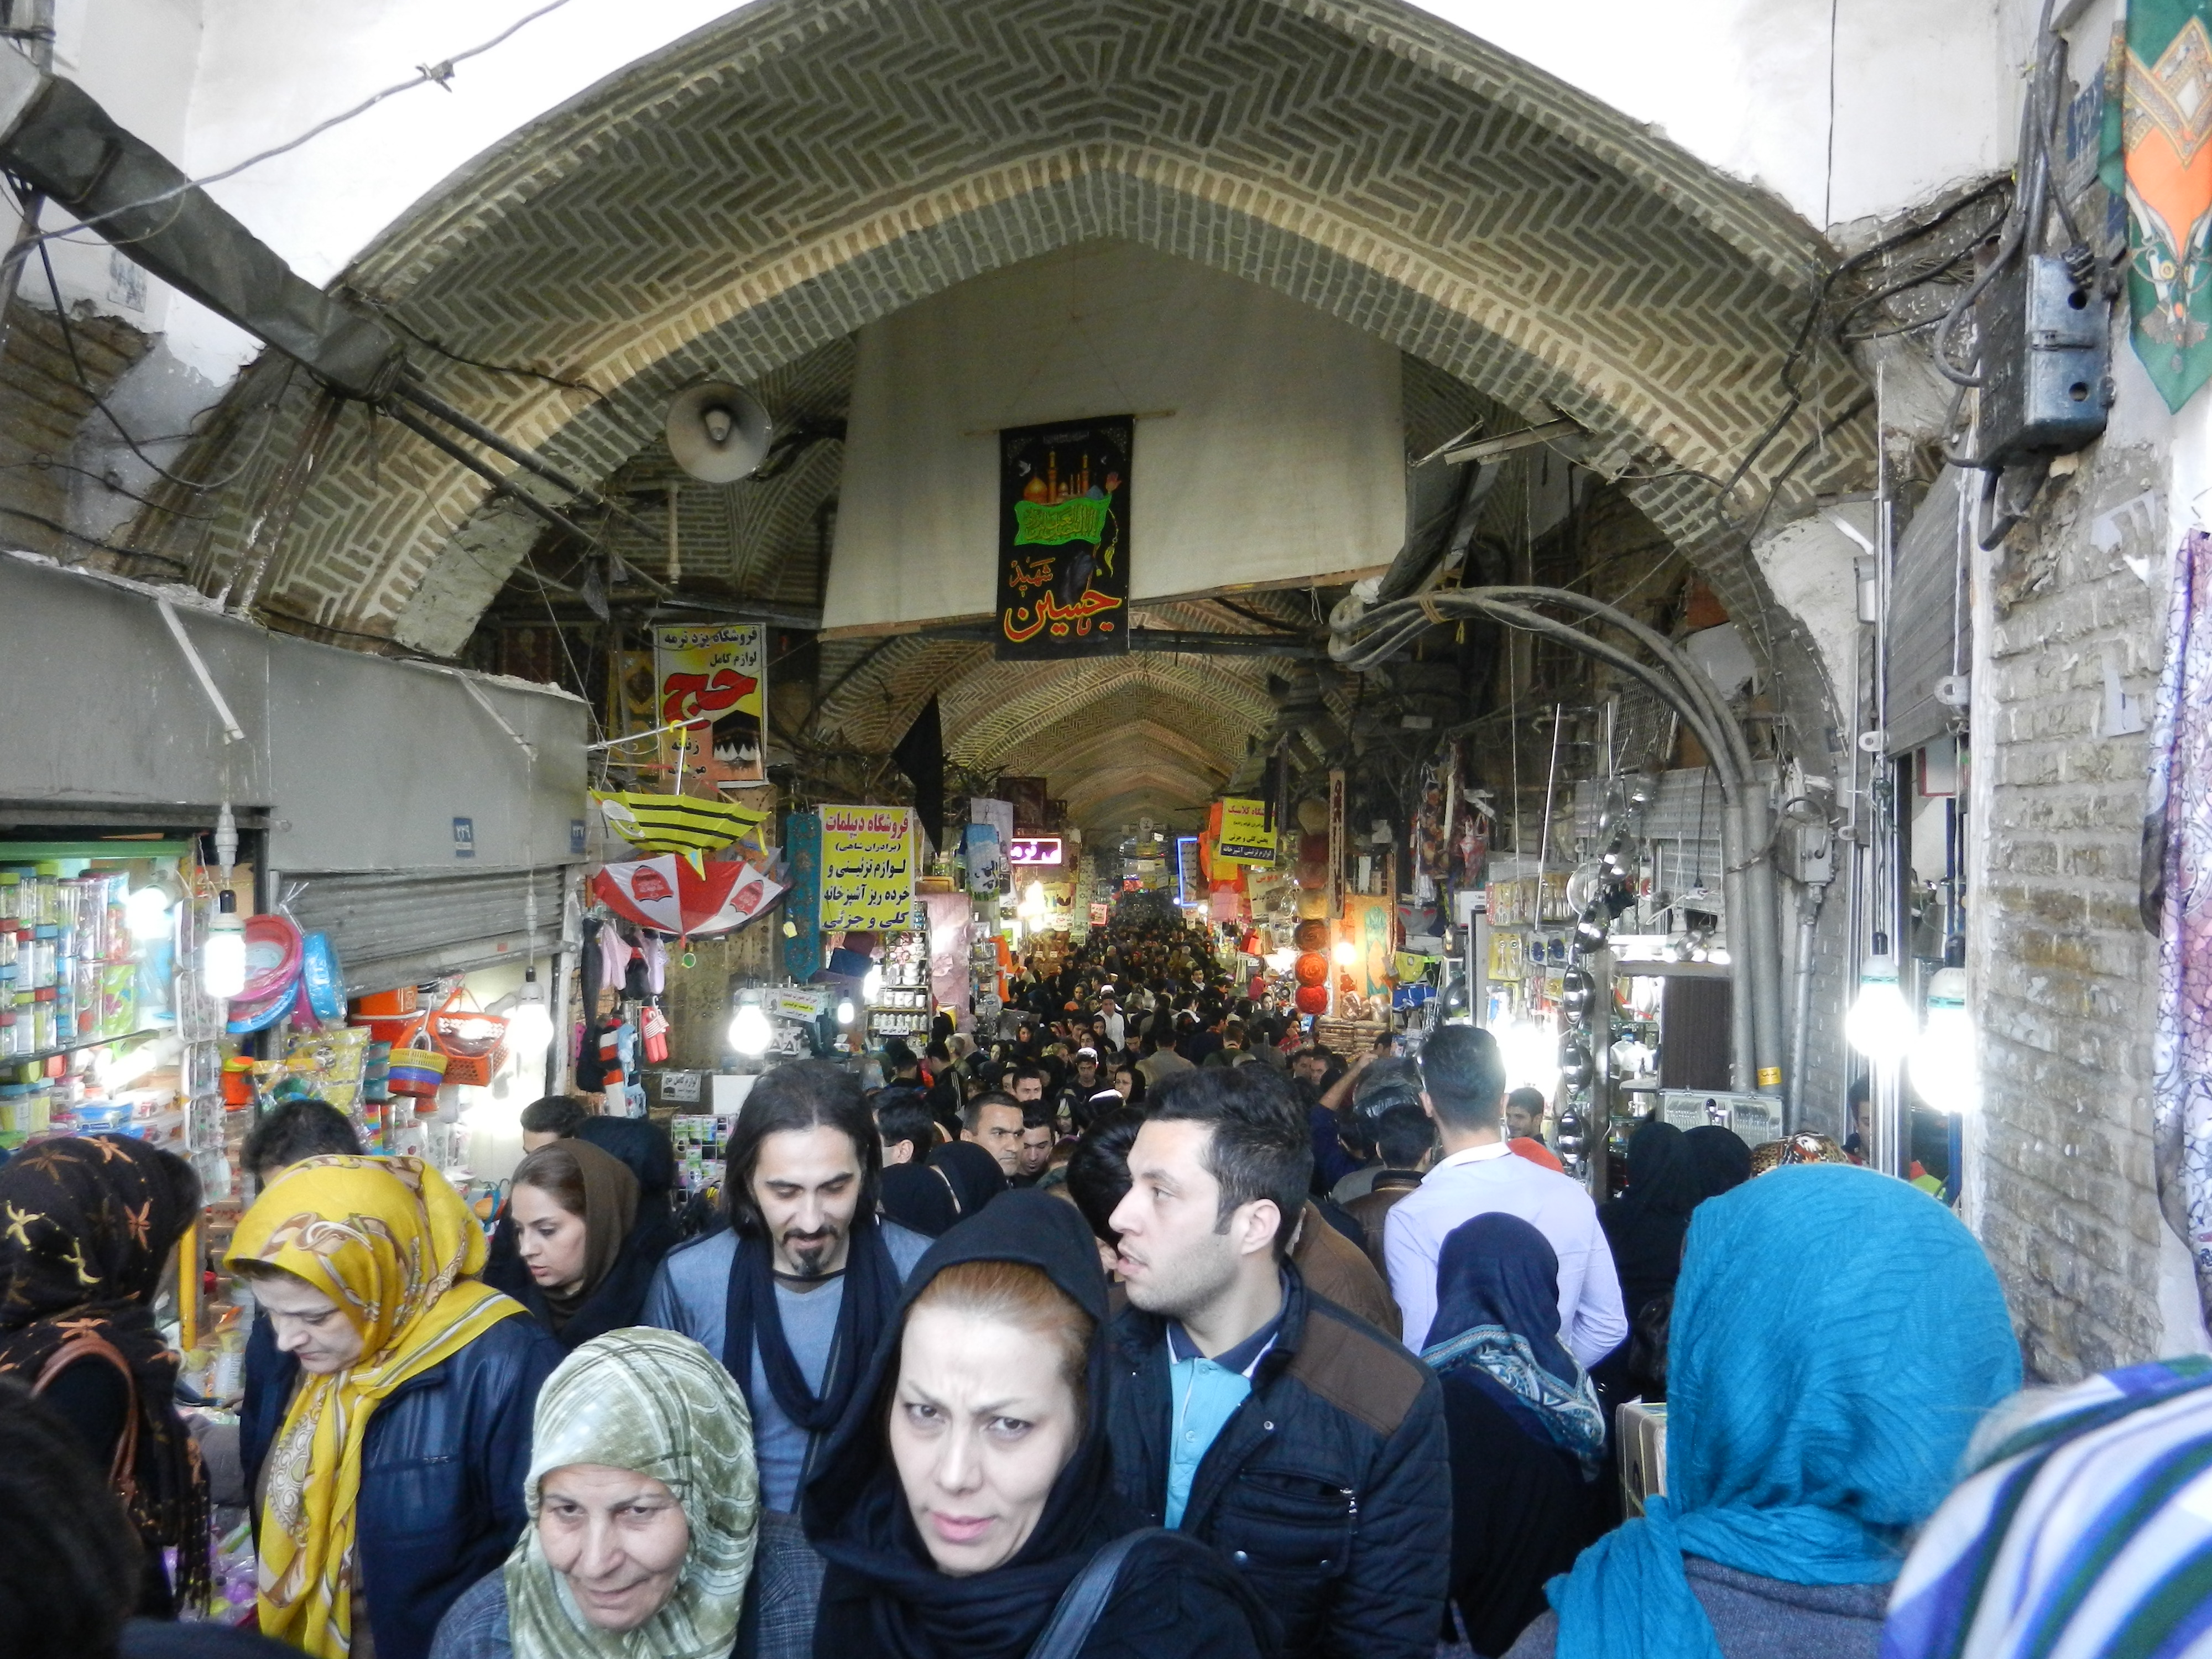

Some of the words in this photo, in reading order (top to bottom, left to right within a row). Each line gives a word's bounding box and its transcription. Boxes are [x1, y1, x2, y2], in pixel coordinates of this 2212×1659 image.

[1009, 557, 1055, 592] شهید
[1004, 589, 1122, 643] حسین
[665, 630, 688, 648] ترمه
[691, 631, 710, 648] یزد
[713, 627, 758, 646] فروشگاه
[709, 653, 732, 667] کامل
[734, 651, 757, 666] لوازم
[663, 668, 758, 731] حج
[826, 812, 865, 838] دیپلمات
[867, 810, 909, 839] فروشگاه
[827, 866, 833, 878] و
[874, 859, 906, 878] لوازم
[824, 884, 865, 906] آشپزخانه
[868, 889, 882, 905] ریز
[885, 886, 910, 905] خرده
[823, 911, 864, 928] جزئی
[867, 917, 875, 928] و
[879, 911, 909, 928] کلی
